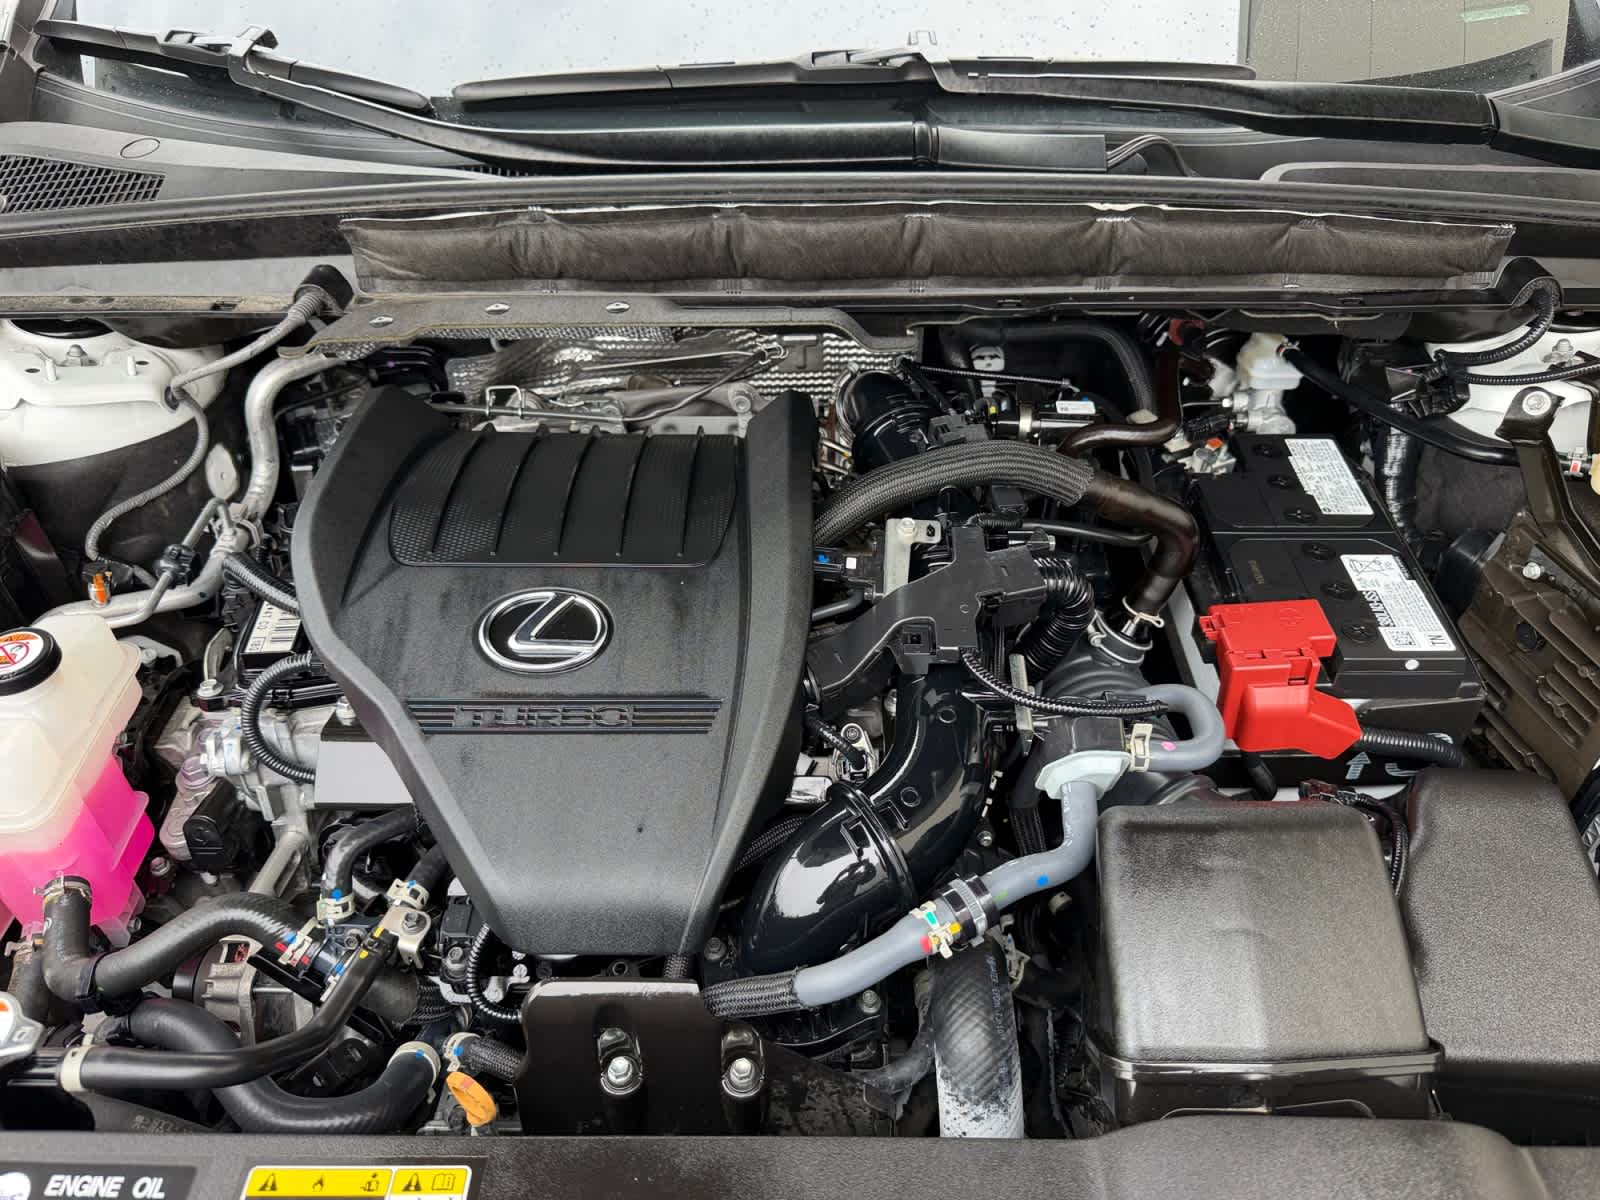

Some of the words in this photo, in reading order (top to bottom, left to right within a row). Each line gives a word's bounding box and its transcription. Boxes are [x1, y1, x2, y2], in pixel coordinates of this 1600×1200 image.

[458, 704, 630, 727] TURBO
[43, 1174, 125, 1198] ENGINE
[132, 1176, 165, 1199] OIL
